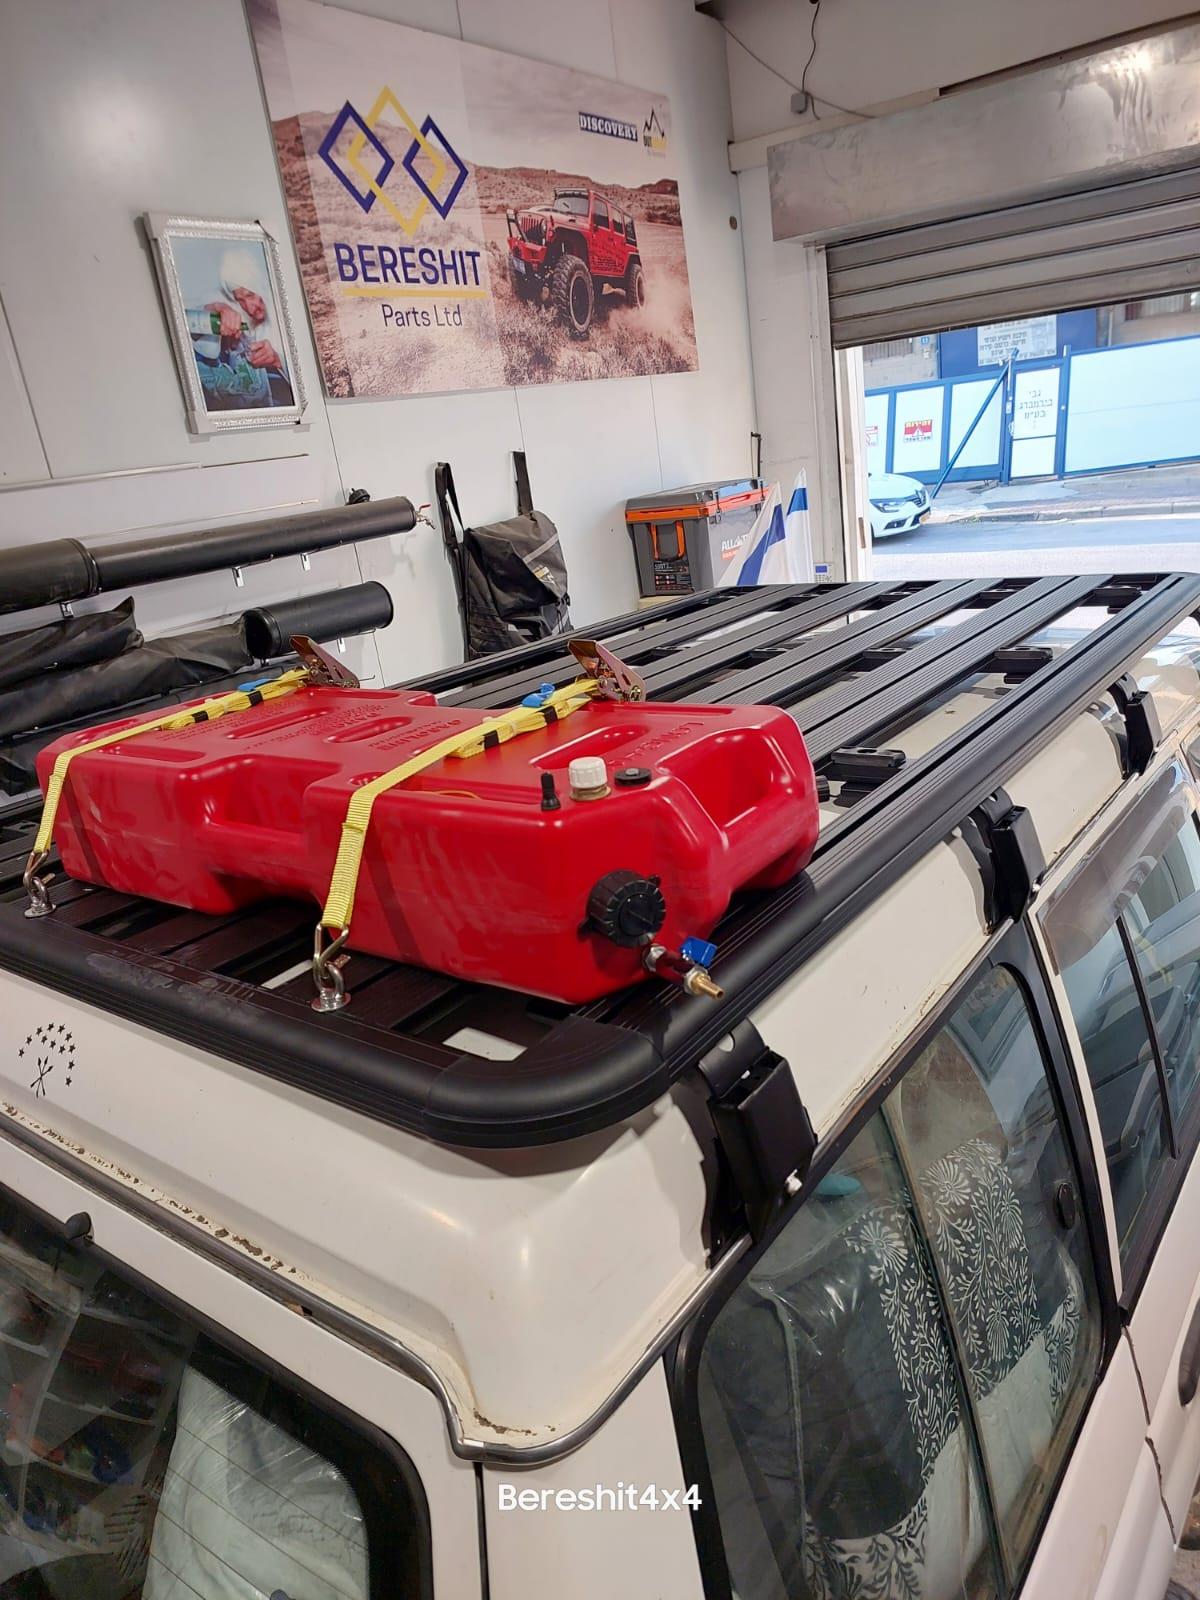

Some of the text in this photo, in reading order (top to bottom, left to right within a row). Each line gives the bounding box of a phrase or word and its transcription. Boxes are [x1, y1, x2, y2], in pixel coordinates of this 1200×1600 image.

[579, 113, 637, 140] DISCOVERY
[334, 242, 481, 286] BERESHIT
[381, 303, 463, 327] Parts Ltd
